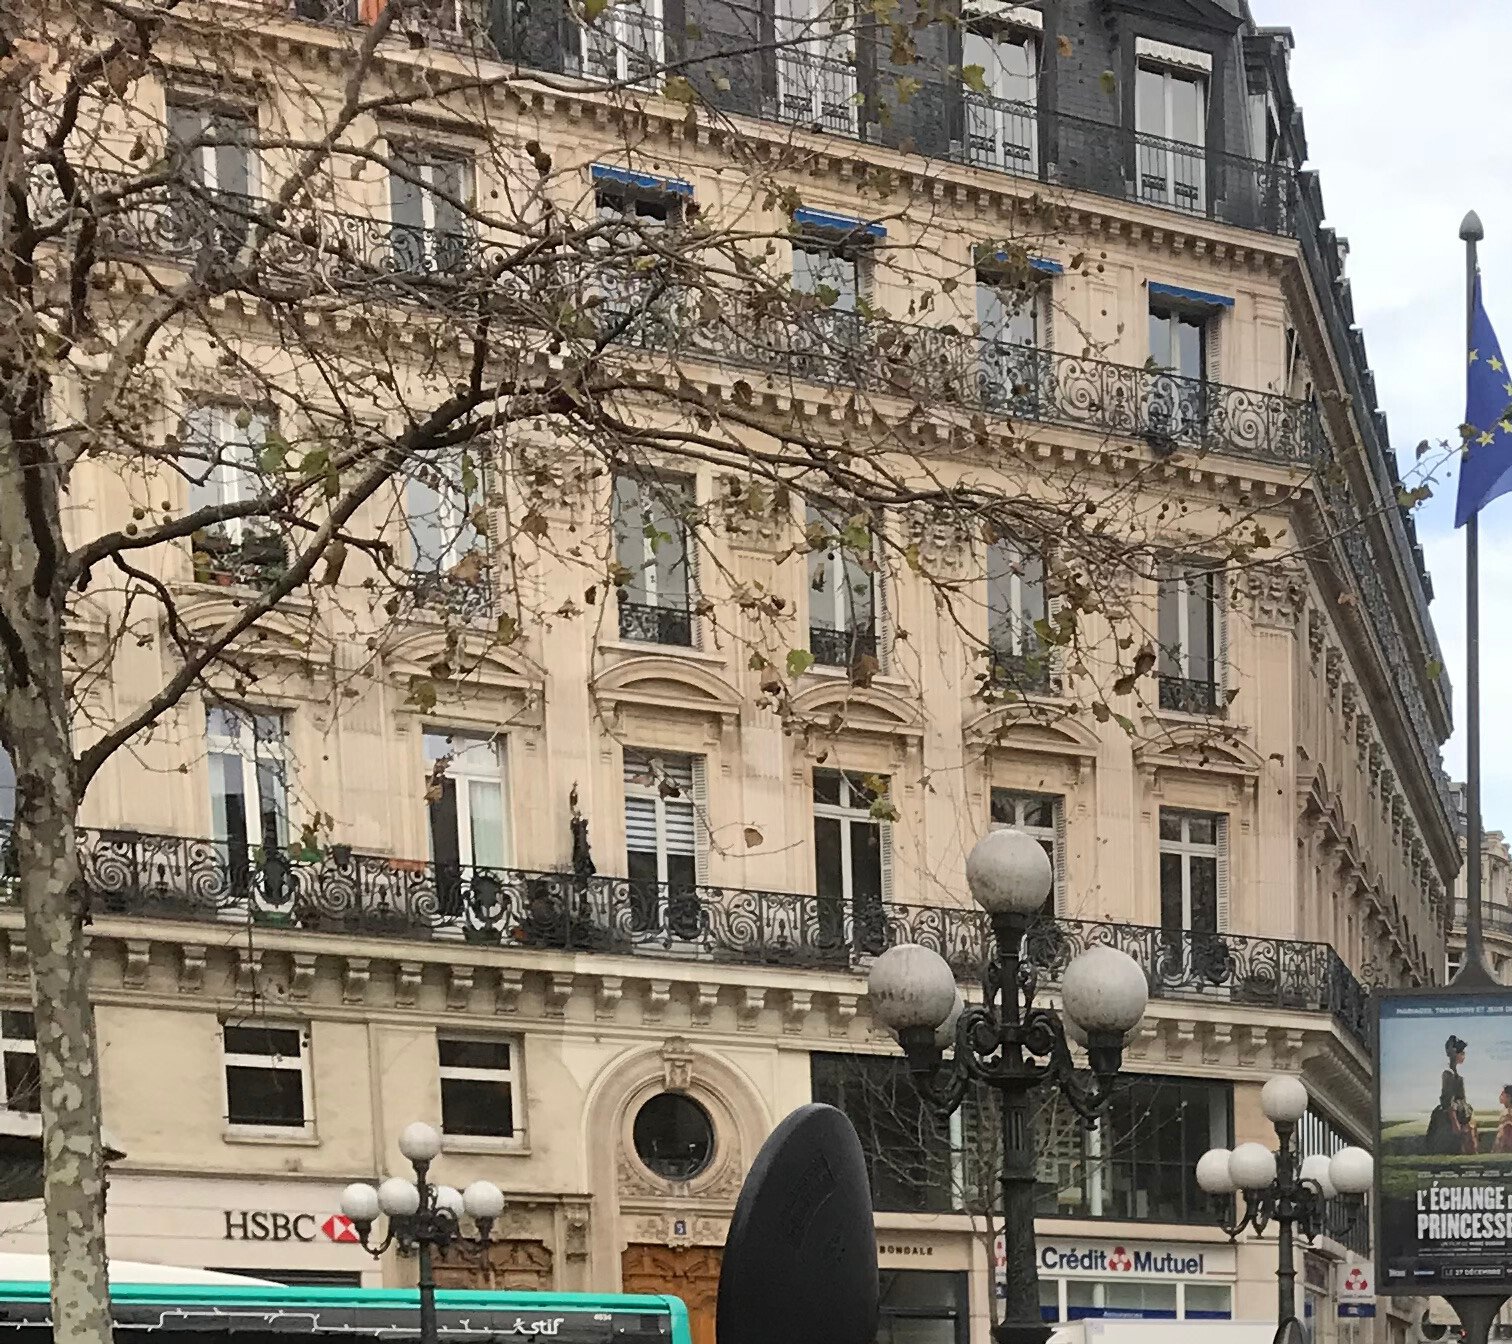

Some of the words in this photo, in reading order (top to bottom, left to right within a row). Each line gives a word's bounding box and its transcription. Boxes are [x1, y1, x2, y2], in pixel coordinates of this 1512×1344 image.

[223, 1210, 317, 1242] HSBC
[1041, 1246, 1108, 1272] Crédit
[1134, 1250, 1204, 1275] Mutuel
